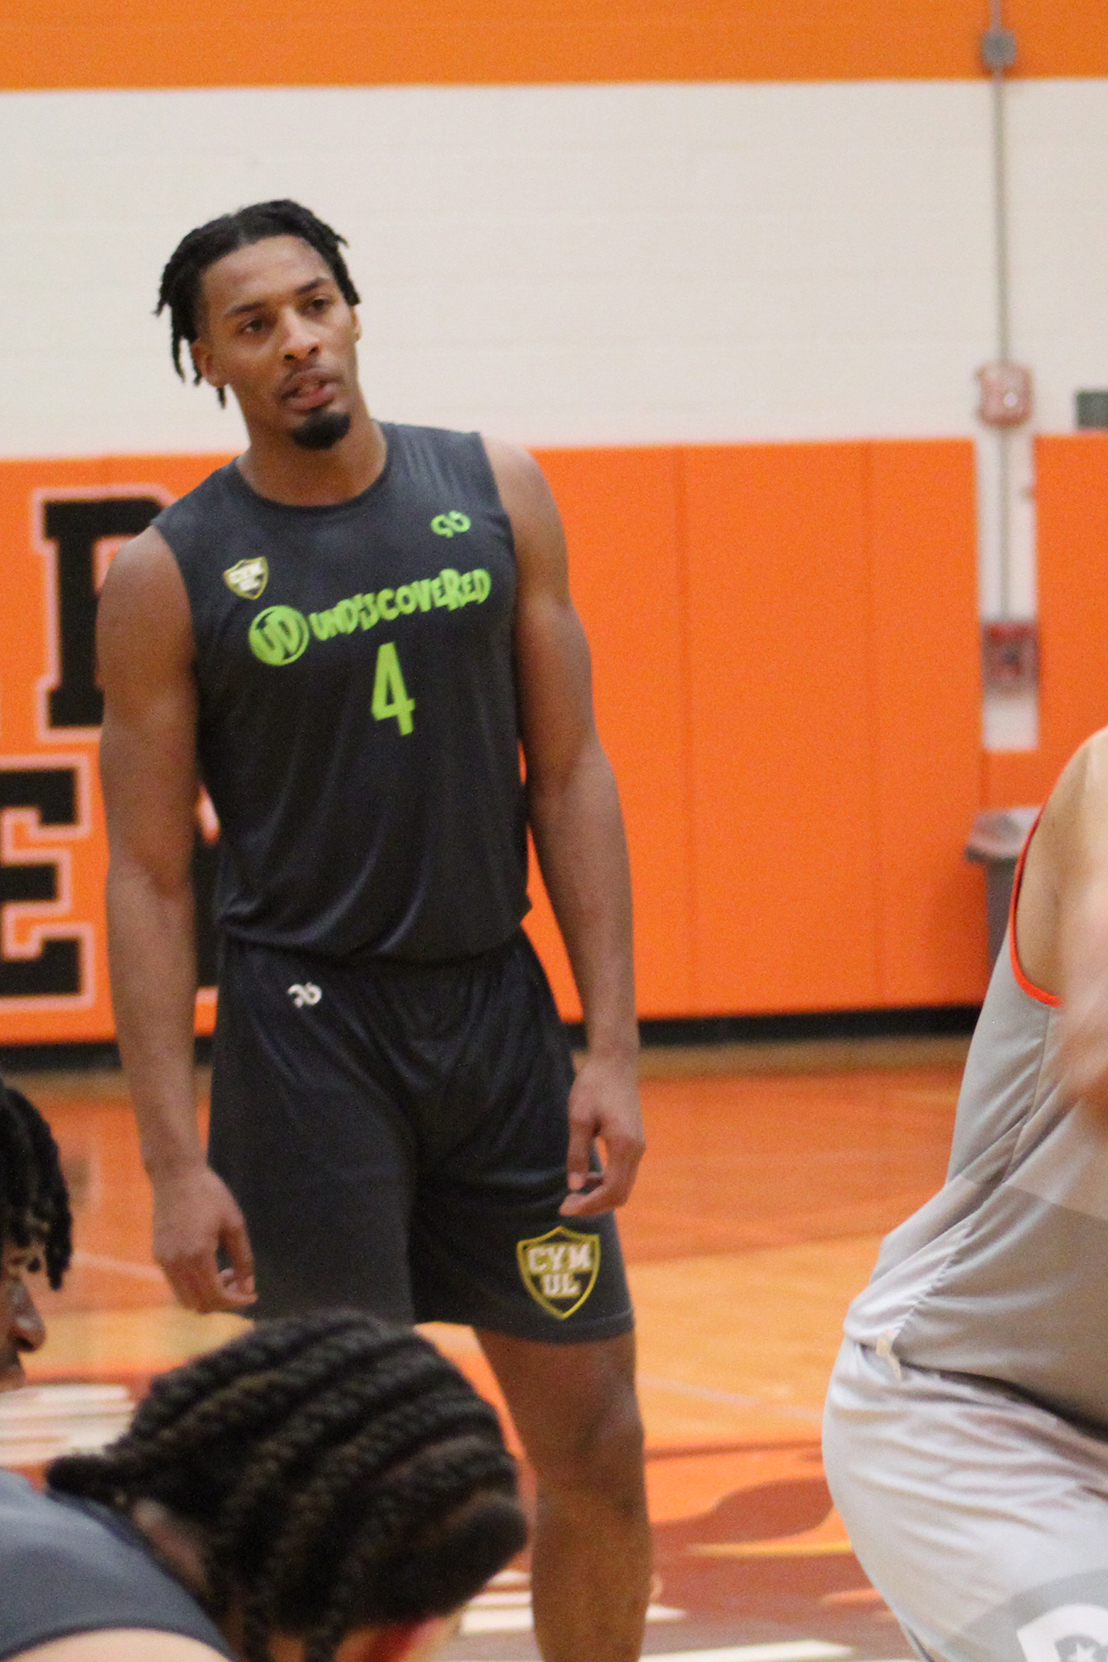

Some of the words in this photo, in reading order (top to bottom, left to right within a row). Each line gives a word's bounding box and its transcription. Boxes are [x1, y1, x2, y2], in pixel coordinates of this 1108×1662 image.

[371, 641, 415, 736] 4
[527, 1243, 591, 1273] CYM
[543, 1273, 580, 1296] UL
